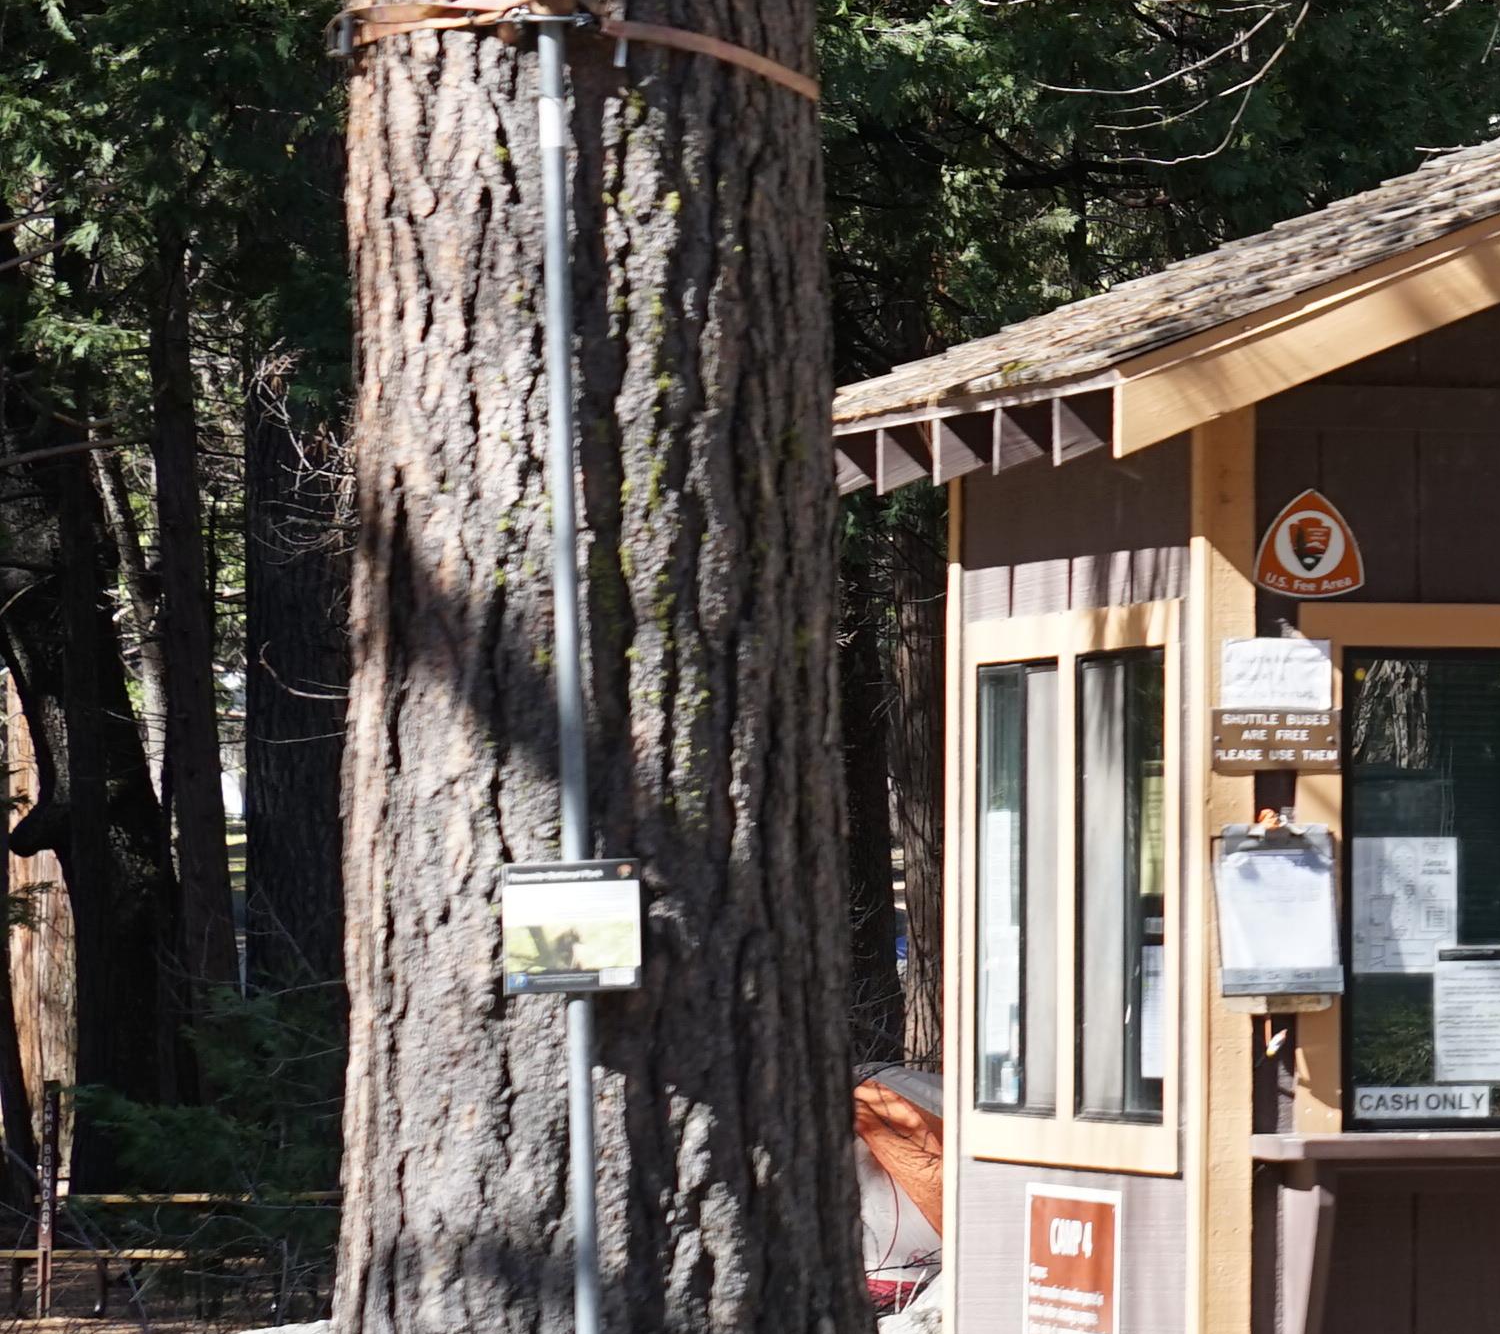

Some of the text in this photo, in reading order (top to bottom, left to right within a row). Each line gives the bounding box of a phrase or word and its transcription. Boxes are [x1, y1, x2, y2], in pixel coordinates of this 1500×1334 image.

[1265, 571, 1352, 591] U.S. Fee Area
[1222, 714, 1330, 725] SHUTTLE BUSES
[1242, 730, 1310, 741] ARE FREE
[1215, 749, 1338, 761] PLEASE USE THEM
[1359, 1092, 1485, 1112] CASH ONLY
[40, 1090, 53, 1235] CAMP BOUNDARY
[1082, 1222, 1093, 1259] 4
